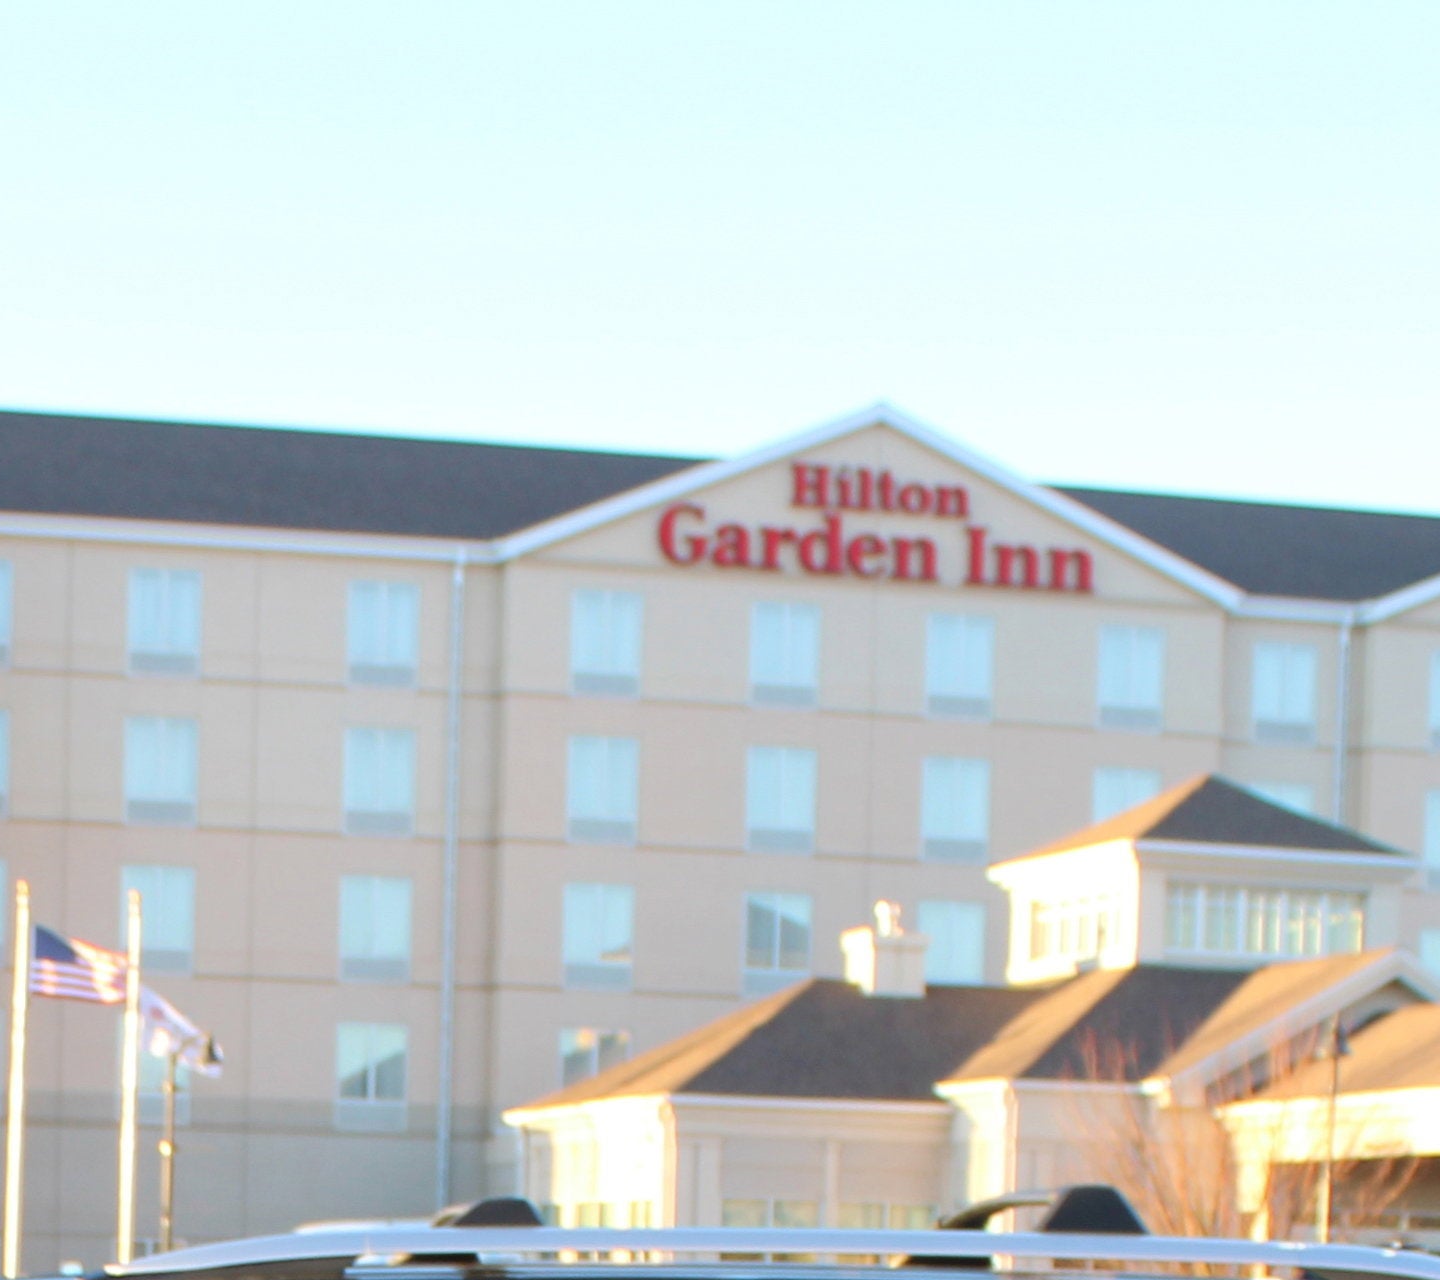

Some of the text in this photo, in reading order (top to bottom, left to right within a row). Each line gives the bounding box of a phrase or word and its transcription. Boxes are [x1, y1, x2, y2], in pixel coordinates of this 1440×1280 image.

[790, 460, 971, 518] Hilton
[657, 502, 1095, 595] Garden Inn
